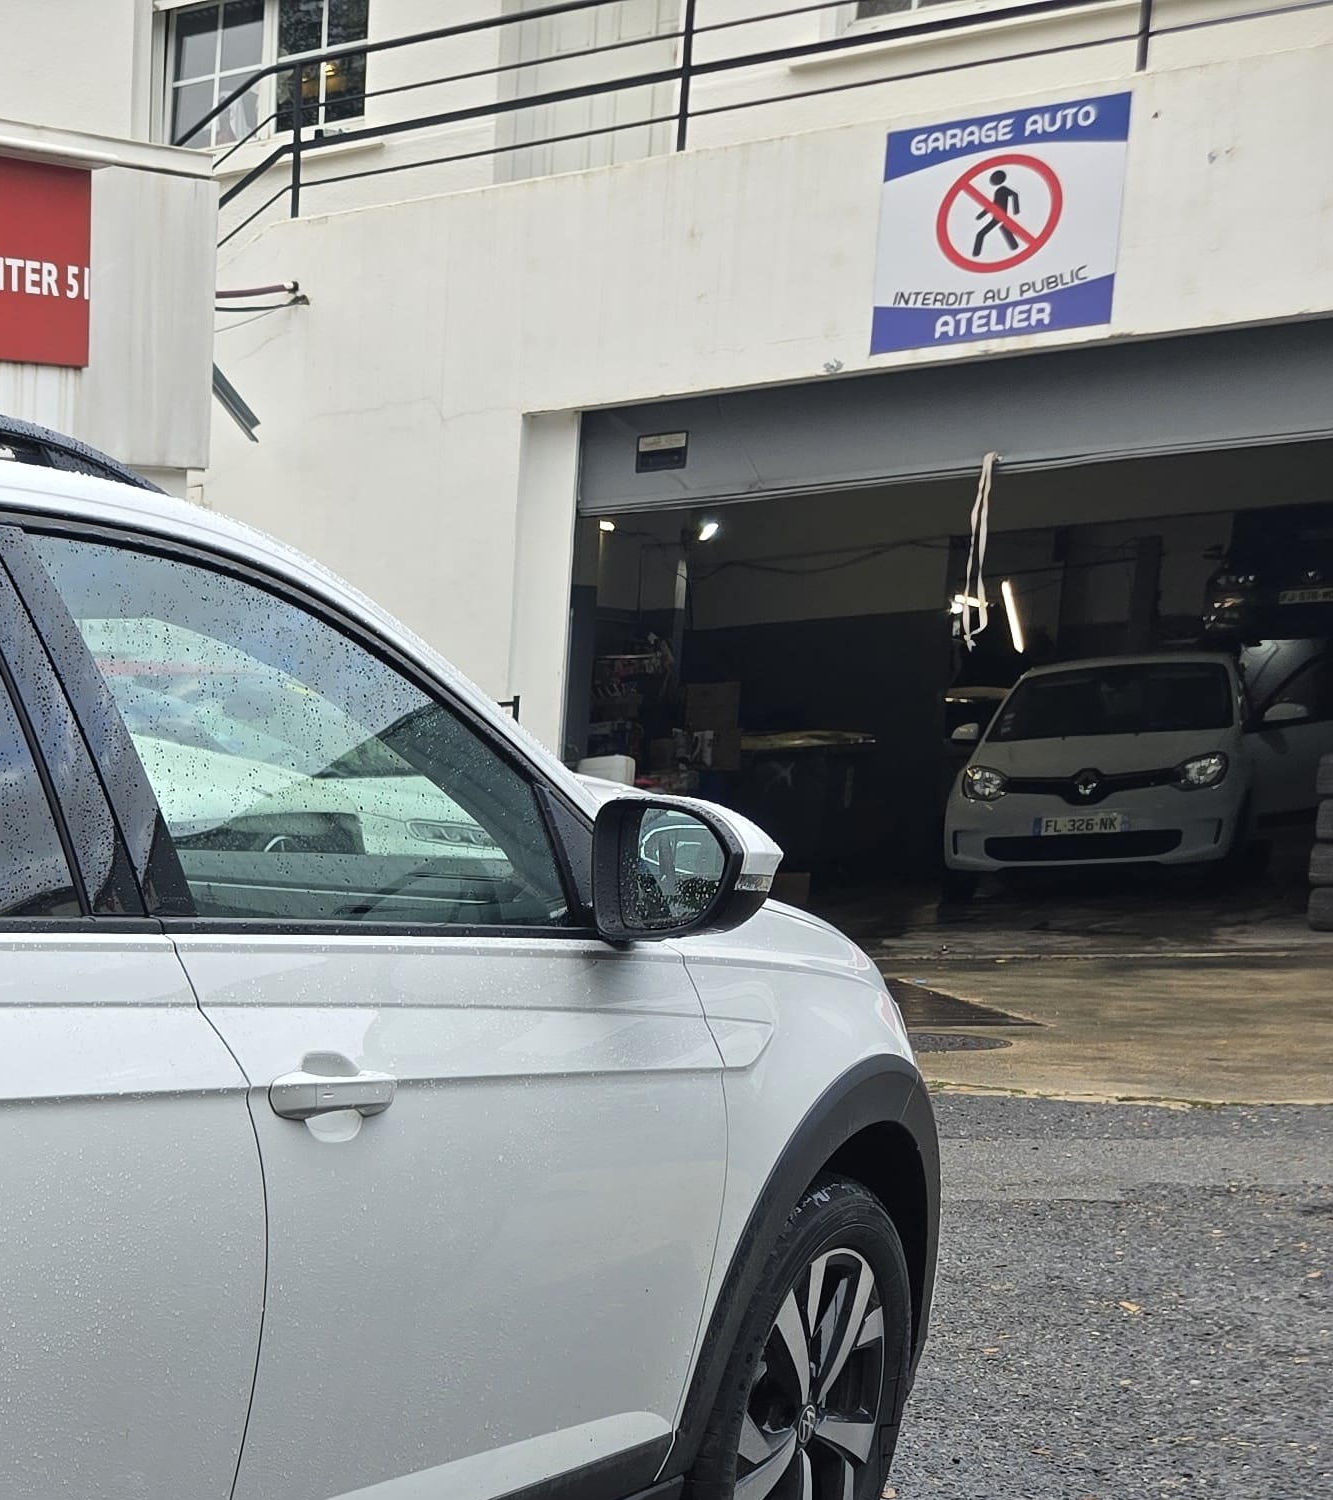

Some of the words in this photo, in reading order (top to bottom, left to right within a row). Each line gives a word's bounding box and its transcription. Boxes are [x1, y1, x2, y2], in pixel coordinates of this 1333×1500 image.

[910, 117, 1015, 156] GARAGE
[1024, 105, 1097, 137] AUTO
[893, 291, 975, 307] INTERDIT
[983, 286, 1011, 304] AU
[1019, 265, 1087, 297] PUBLIC
[934, 302, 1052, 339] ATELIER
